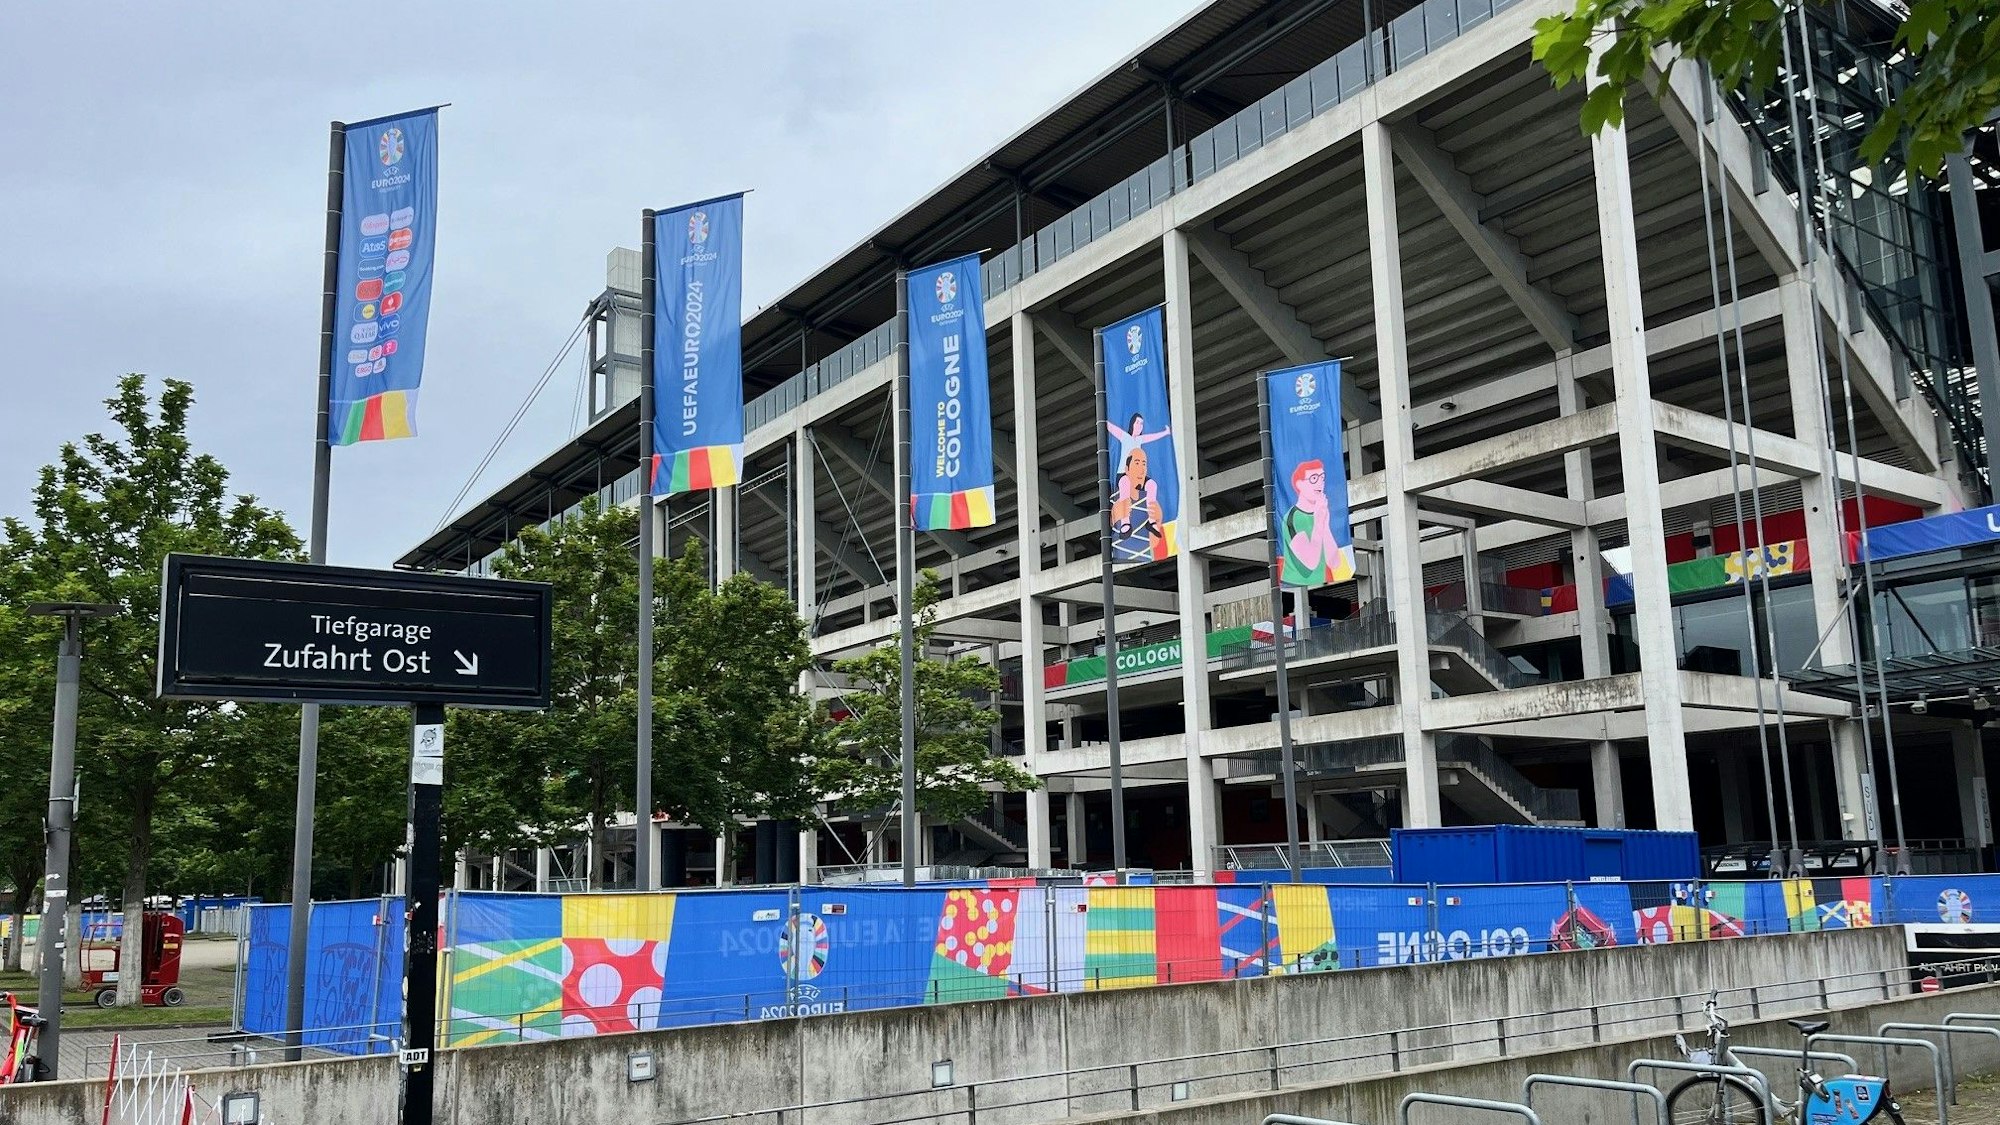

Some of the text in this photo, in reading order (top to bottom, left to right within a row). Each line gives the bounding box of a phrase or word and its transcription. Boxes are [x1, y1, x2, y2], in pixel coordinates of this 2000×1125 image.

[371, 173, 411, 189] EURO2024
[683, 281, 704, 437] UEFAEURO2024
[943, 334, 961, 478] COLOGNE
[936, 401, 946, 478] WELCOME TO
[310, 614, 432, 645] Tiefgarage
[263, 643, 431, 674] Zufahrt Ost
[1116, 644, 1181, 670] COLOGN
